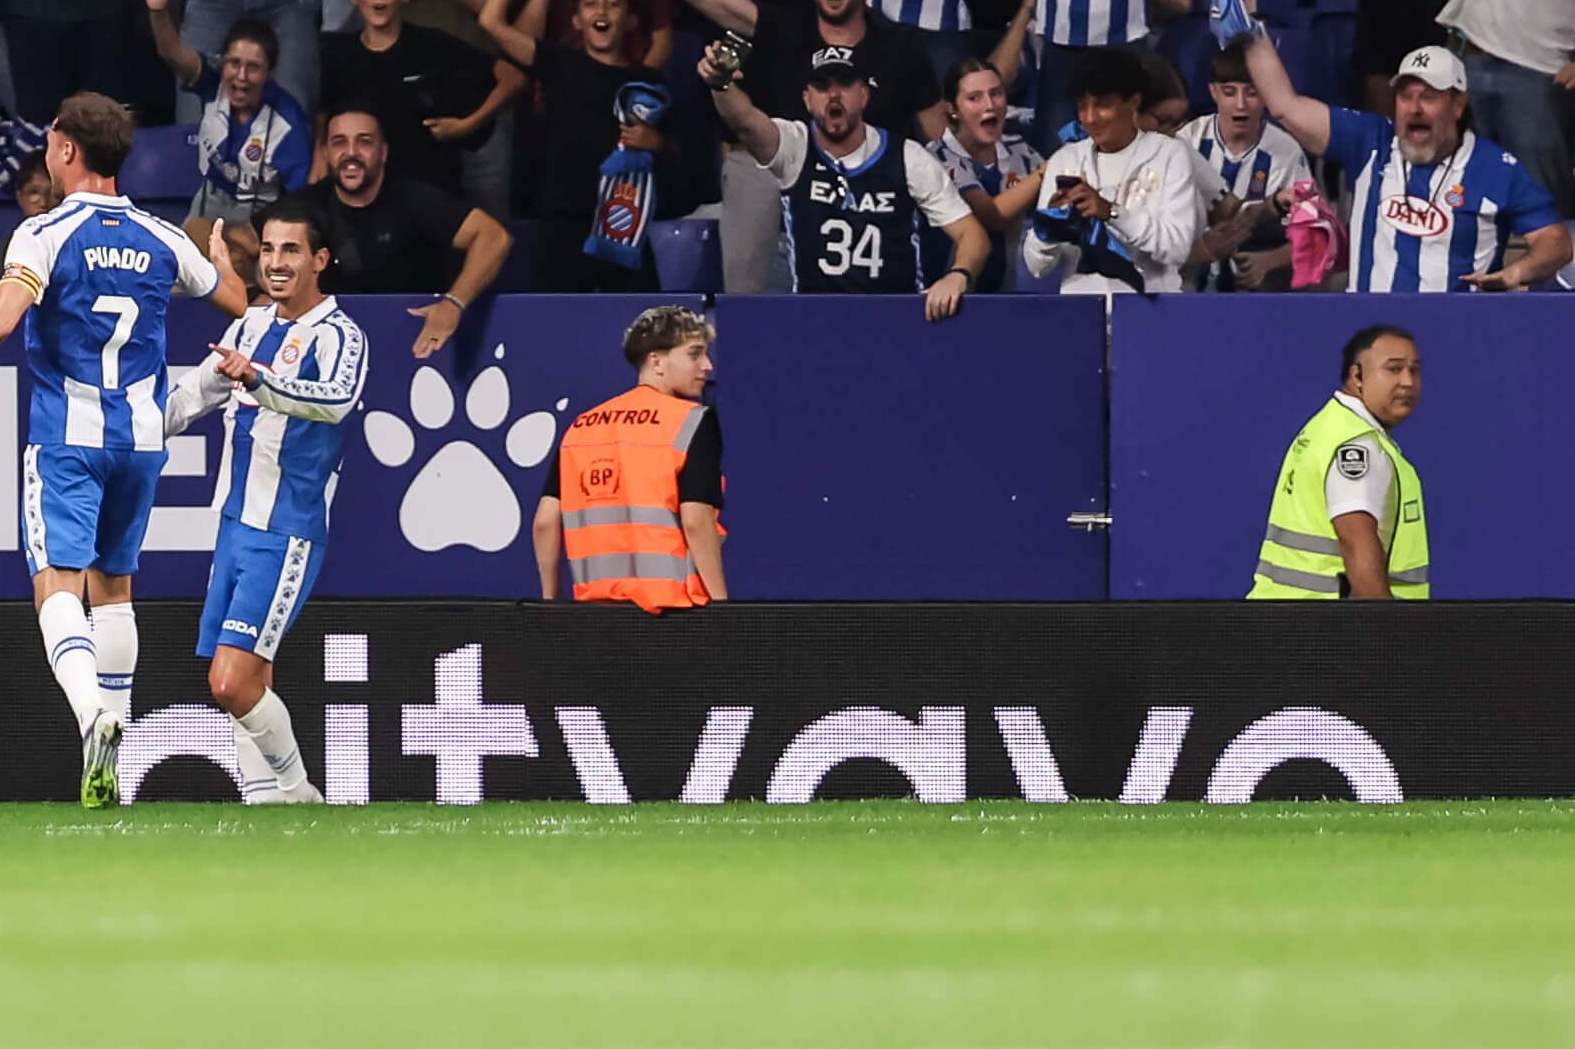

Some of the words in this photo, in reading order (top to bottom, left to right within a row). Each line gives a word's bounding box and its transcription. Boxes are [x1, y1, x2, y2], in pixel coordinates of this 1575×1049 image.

[812, 46, 854, 68] EA7
[1386, 199, 1436, 231] DANI
[83, 246, 151, 274] PUADO
[818, 218, 884, 278] 34
[91, 295, 139, 390] 7
[574, 409, 660, 428] CONTROL
[590, 468, 613, 486] BP
[222, 619, 258, 638] ODA
